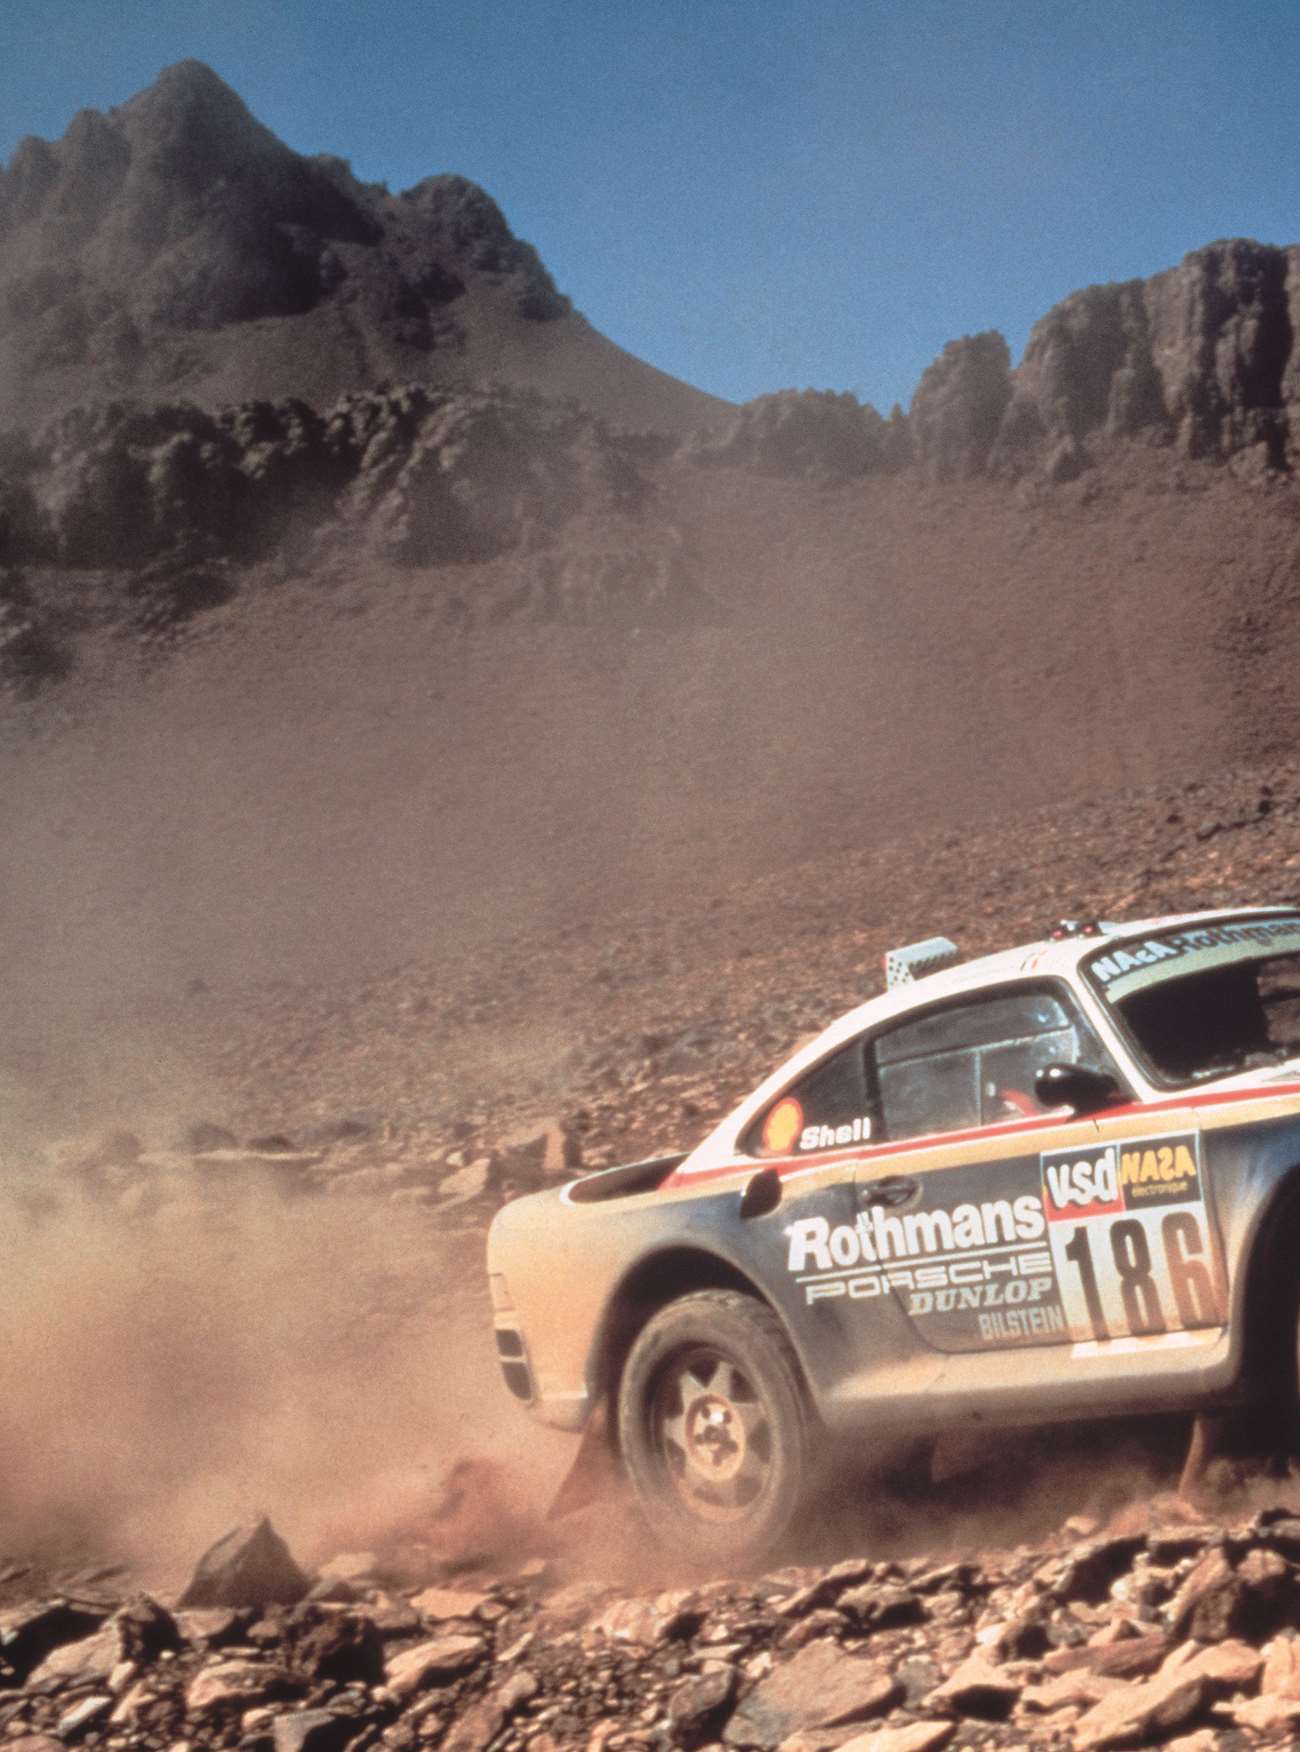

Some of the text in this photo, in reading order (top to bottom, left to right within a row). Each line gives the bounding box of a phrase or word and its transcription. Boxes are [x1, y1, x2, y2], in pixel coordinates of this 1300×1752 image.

[800, 1117, 871, 1150] Shell
[787, 1196, 1045, 1271] Rothmans
[806, 1253, 1053, 1305] PORSCHE
[908, 1278, 1053, 1316] DUNLOP
[1065, 1211, 1211, 1341] 186
[978, 1305, 1063, 1340] BILSTEIN
